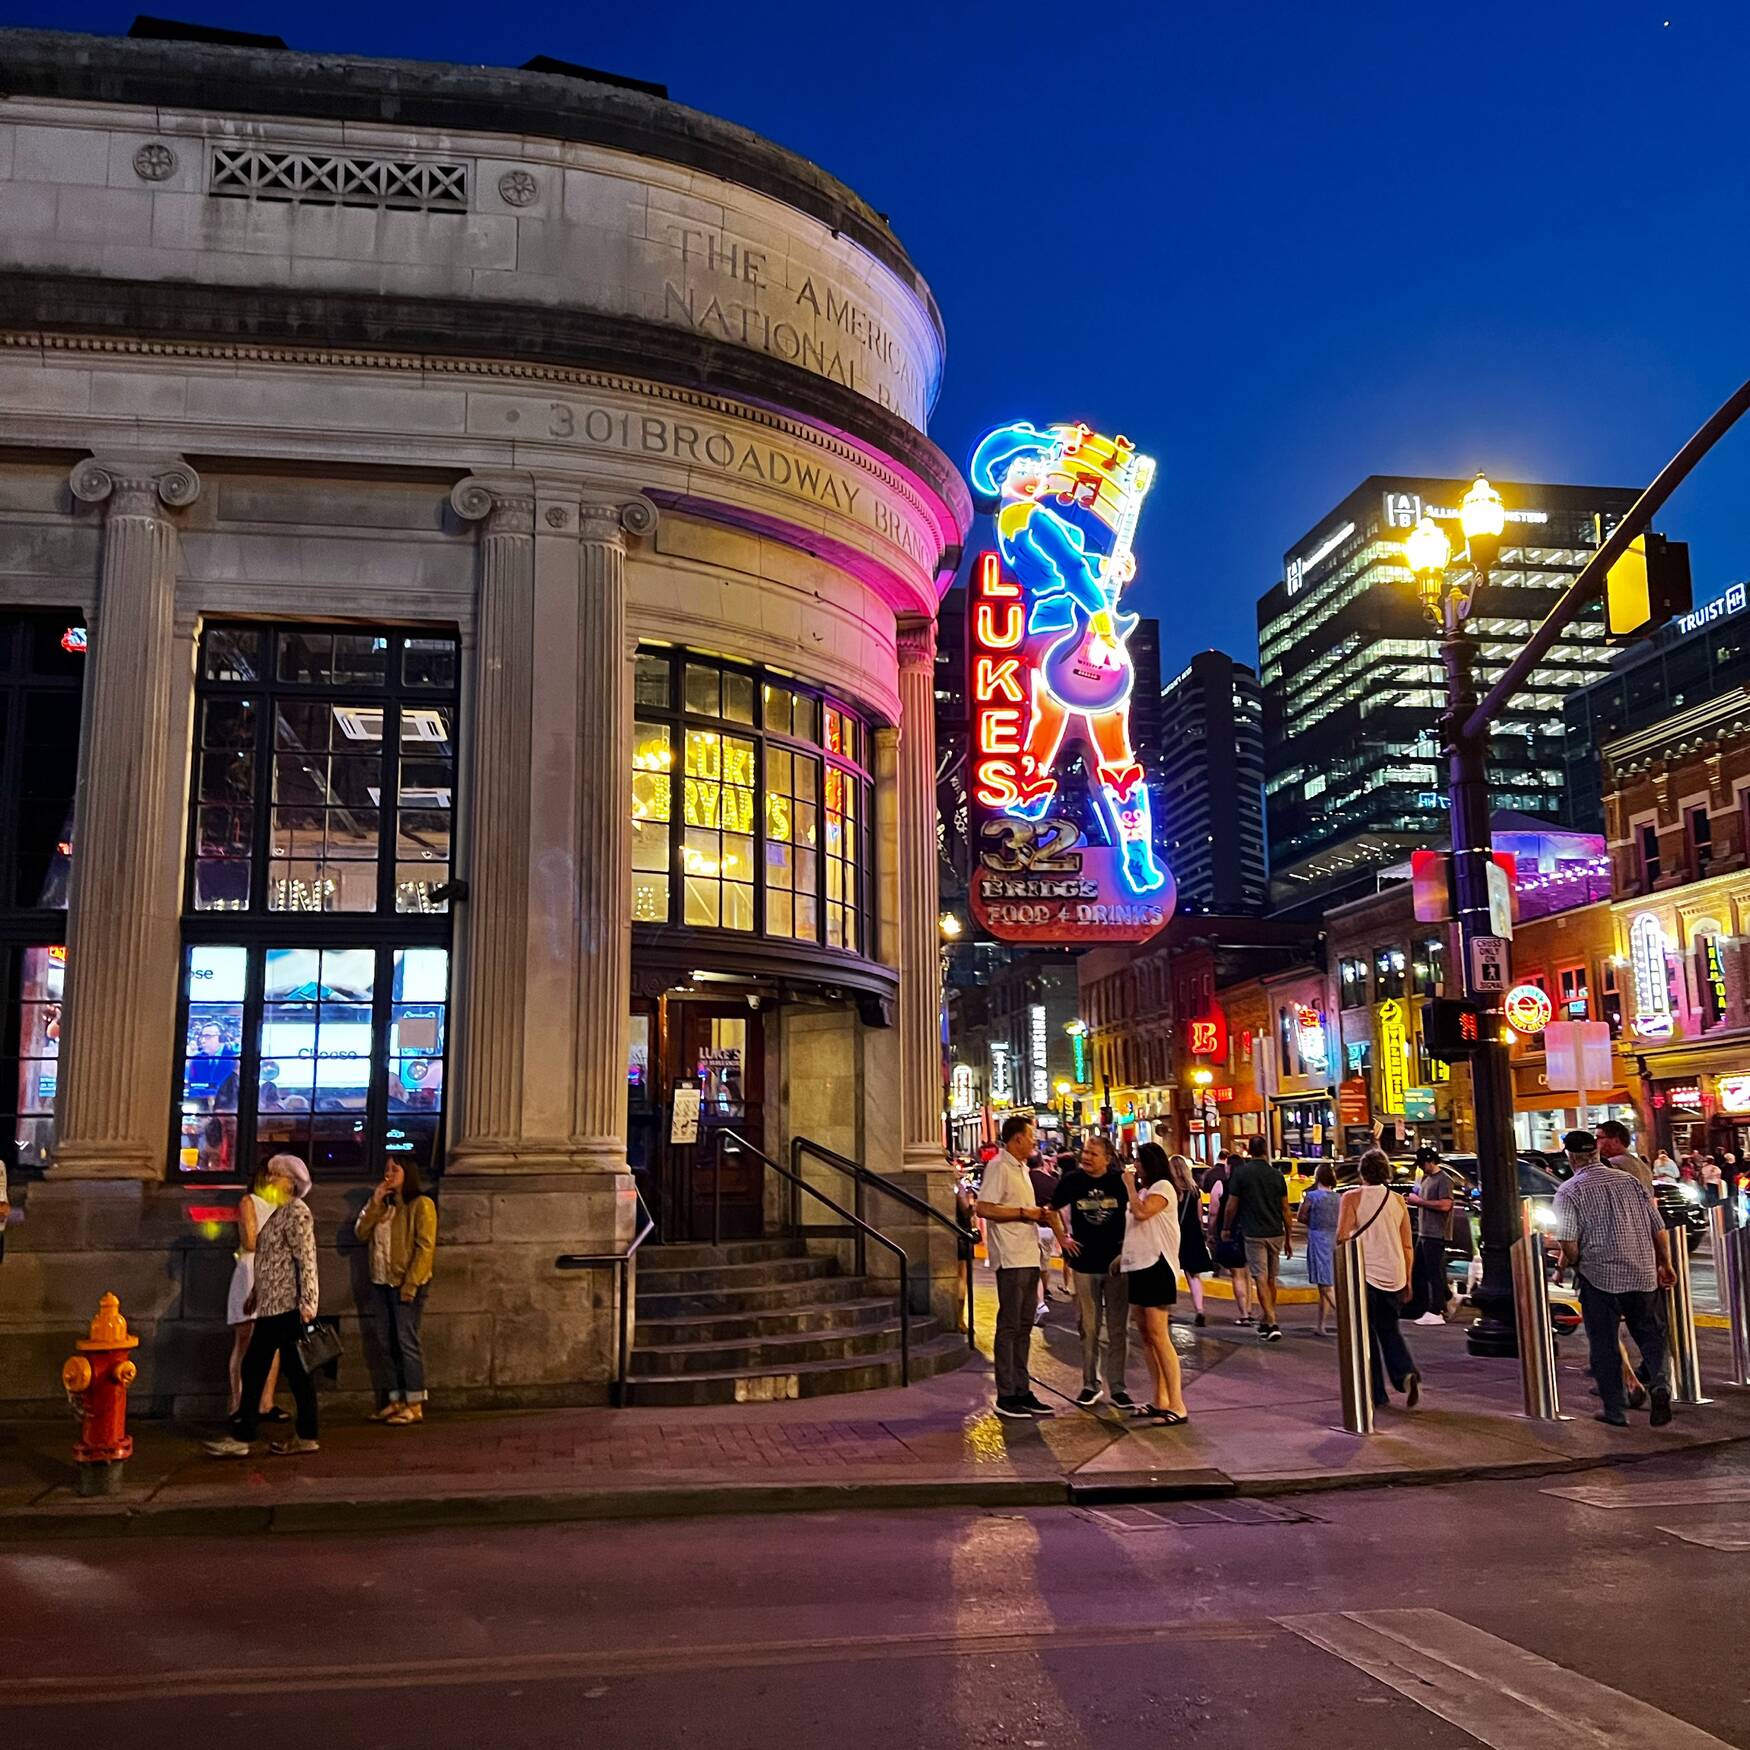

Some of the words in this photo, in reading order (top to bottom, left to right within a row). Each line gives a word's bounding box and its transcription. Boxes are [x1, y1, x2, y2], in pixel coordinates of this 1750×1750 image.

[666, 225, 767, 290] THE
[549, 403, 629, 447] 301
[641, 416, 860, 515] BROADWAY
[1678, 598, 1725, 634] TRUIST
[975, 552, 1035, 809] LUKE'S
[981, 818, 1083, 872] 32
[982, 879, 1098, 899] BRIDGE
[987, 905, 1050, 926] FOOD
[1076, 904, 1164, 926] DRINKS
[1032, 1005, 1047, 1068] WHISKEY
[1034, 1069, 1048, 1104] ROW
